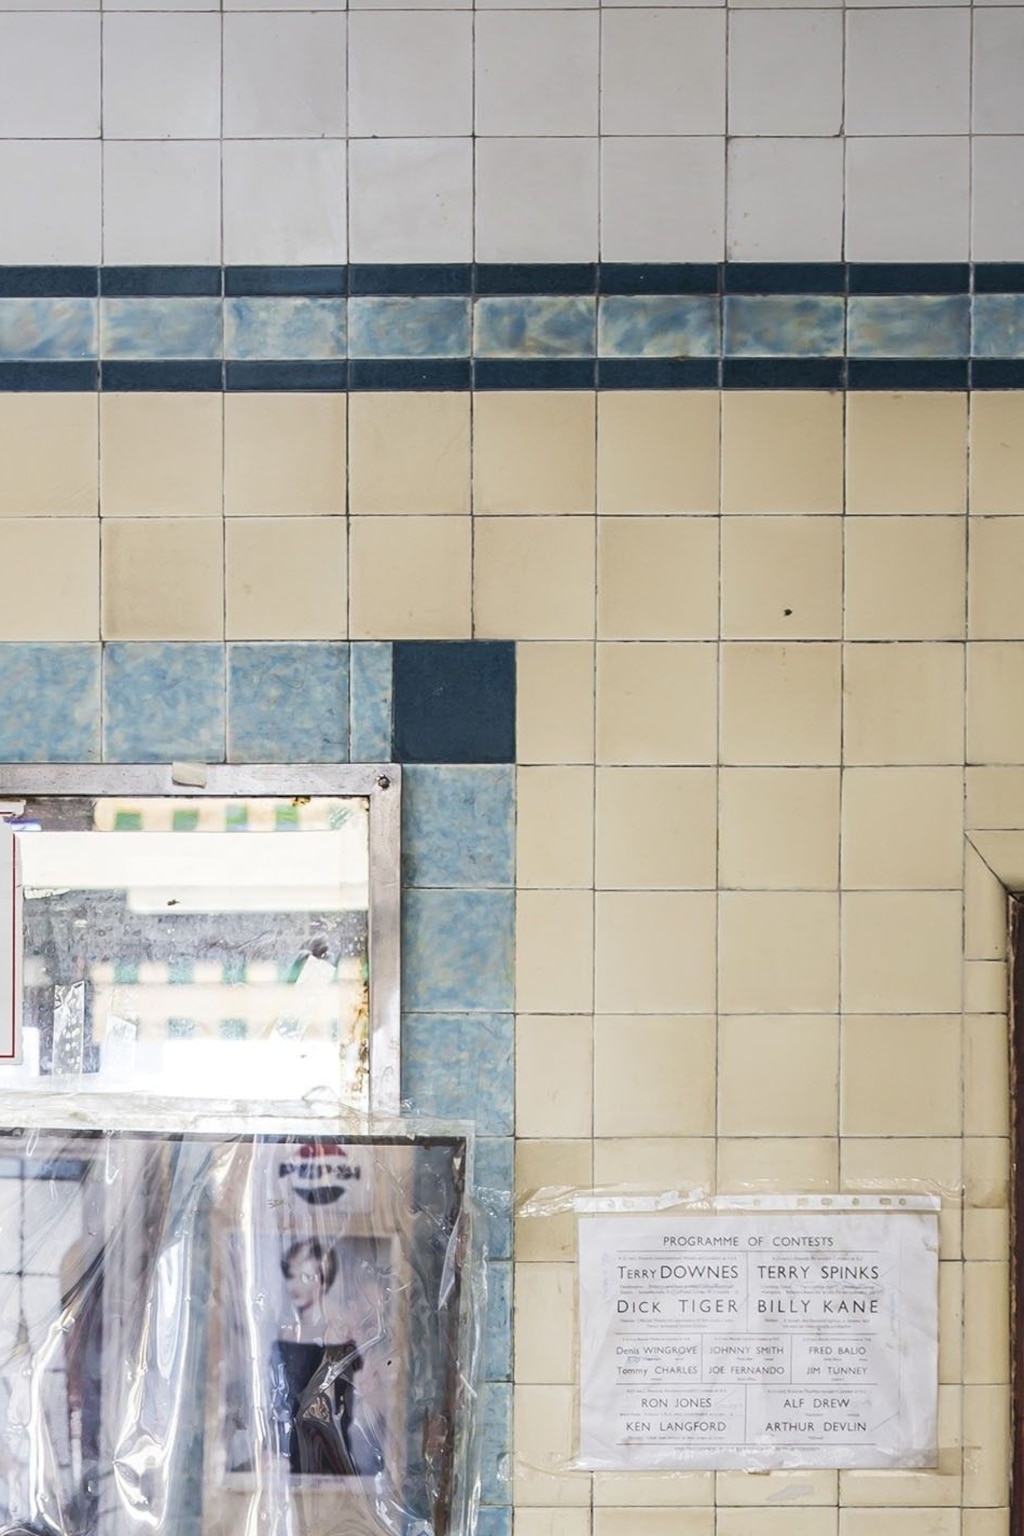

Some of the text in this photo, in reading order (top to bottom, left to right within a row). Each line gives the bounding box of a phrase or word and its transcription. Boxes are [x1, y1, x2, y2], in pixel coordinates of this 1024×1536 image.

[664, 1236, 833, 1247] PROGRAMME OF CONTESTS
[660, 1265, 738, 1279] DOWNES
[757, 1266, 878, 1279] TERRY SPINKS
[679, 1299, 737, 1313] TIGER
[758, 1298, 878, 1313] BILLY KANE
[643, 1346, 696, 1354] WINGROVE
[710, 1346, 783, 1354] JOHNNY SMITH
[618, 1366, 697, 1375] Tommy CHARLES
[709, 1366, 784, 1374] JOE FERNANDO
[807, 1367, 820, 1375] JIM
[642, 1398, 712, 1408] RON JONES
[784, 1399, 850, 1408] ALF DREW
[626, 1421, 726, 1431] KEN LANGFORD
[765, 1422, 866, 1431] ARTHUR DEVLIN
